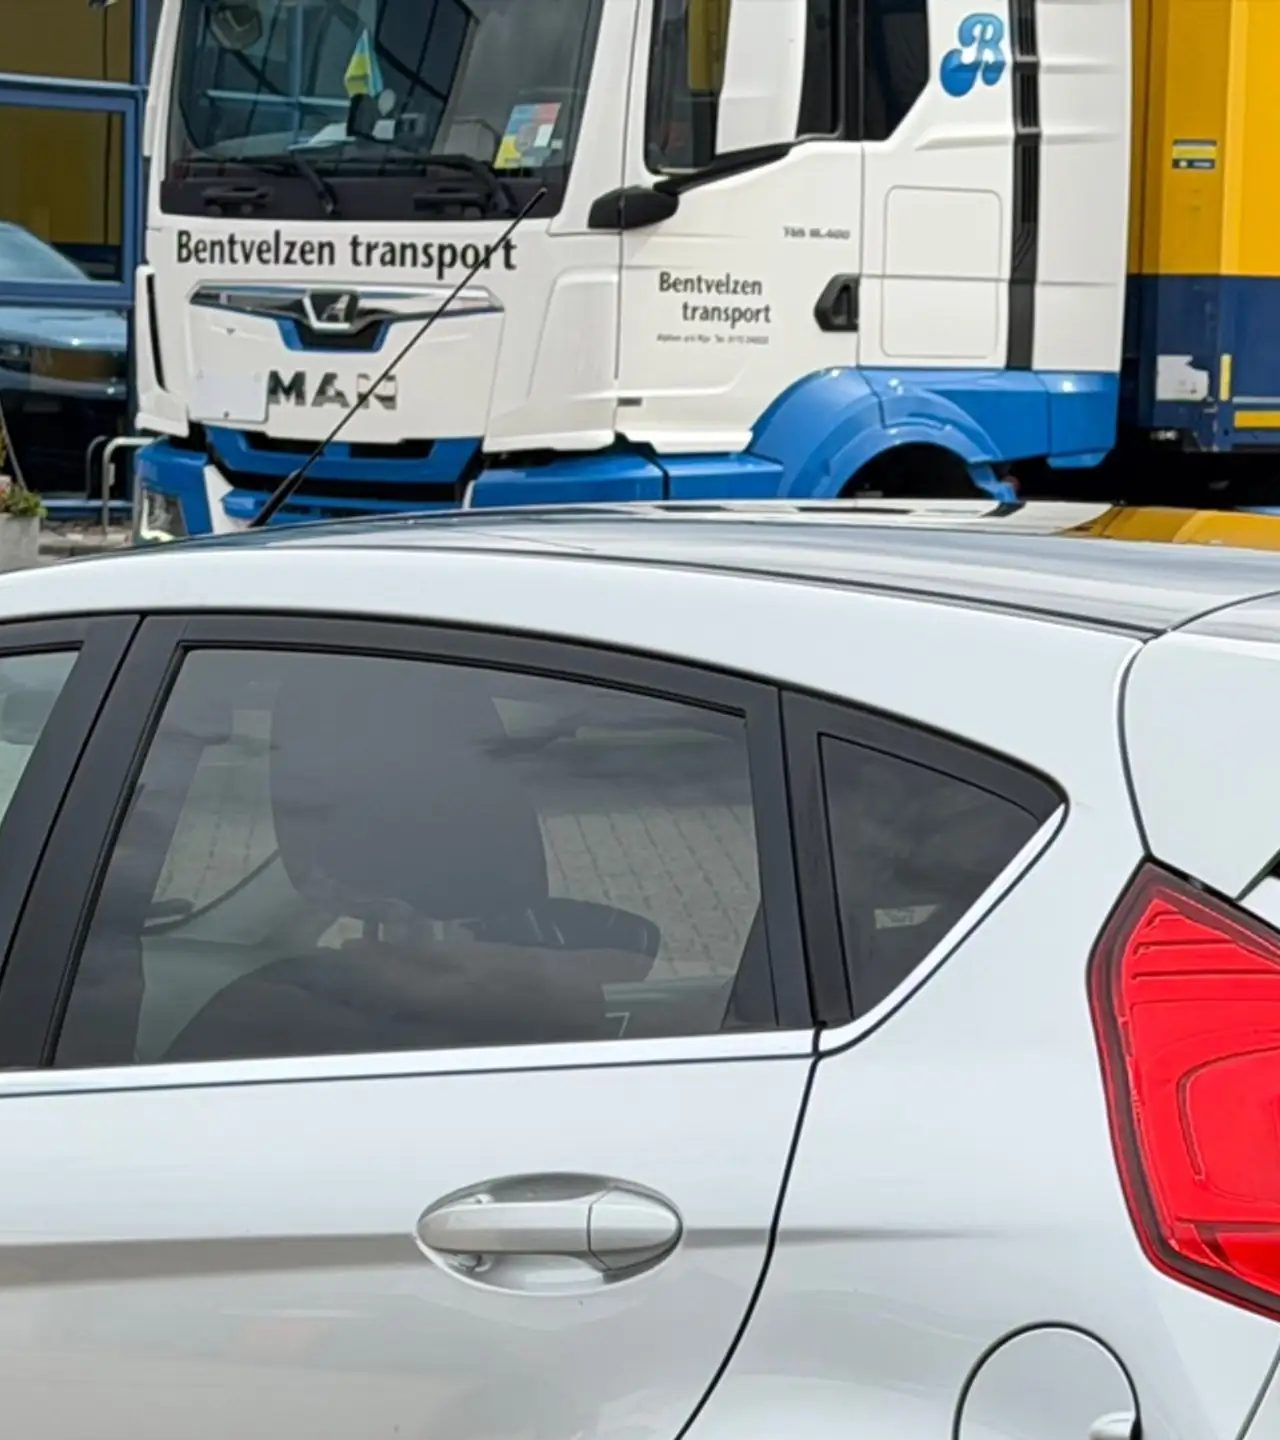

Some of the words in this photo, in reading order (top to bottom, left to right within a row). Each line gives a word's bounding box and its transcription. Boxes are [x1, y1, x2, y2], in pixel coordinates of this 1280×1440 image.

[176, 229, 336, 266] Bentvelzen
[350, 234, 518, 280] transport
[658, 271, 763, 296] Bentvelzen
[681, 301, 772, 330] transport
[270, 369, 398, 410] MAN
